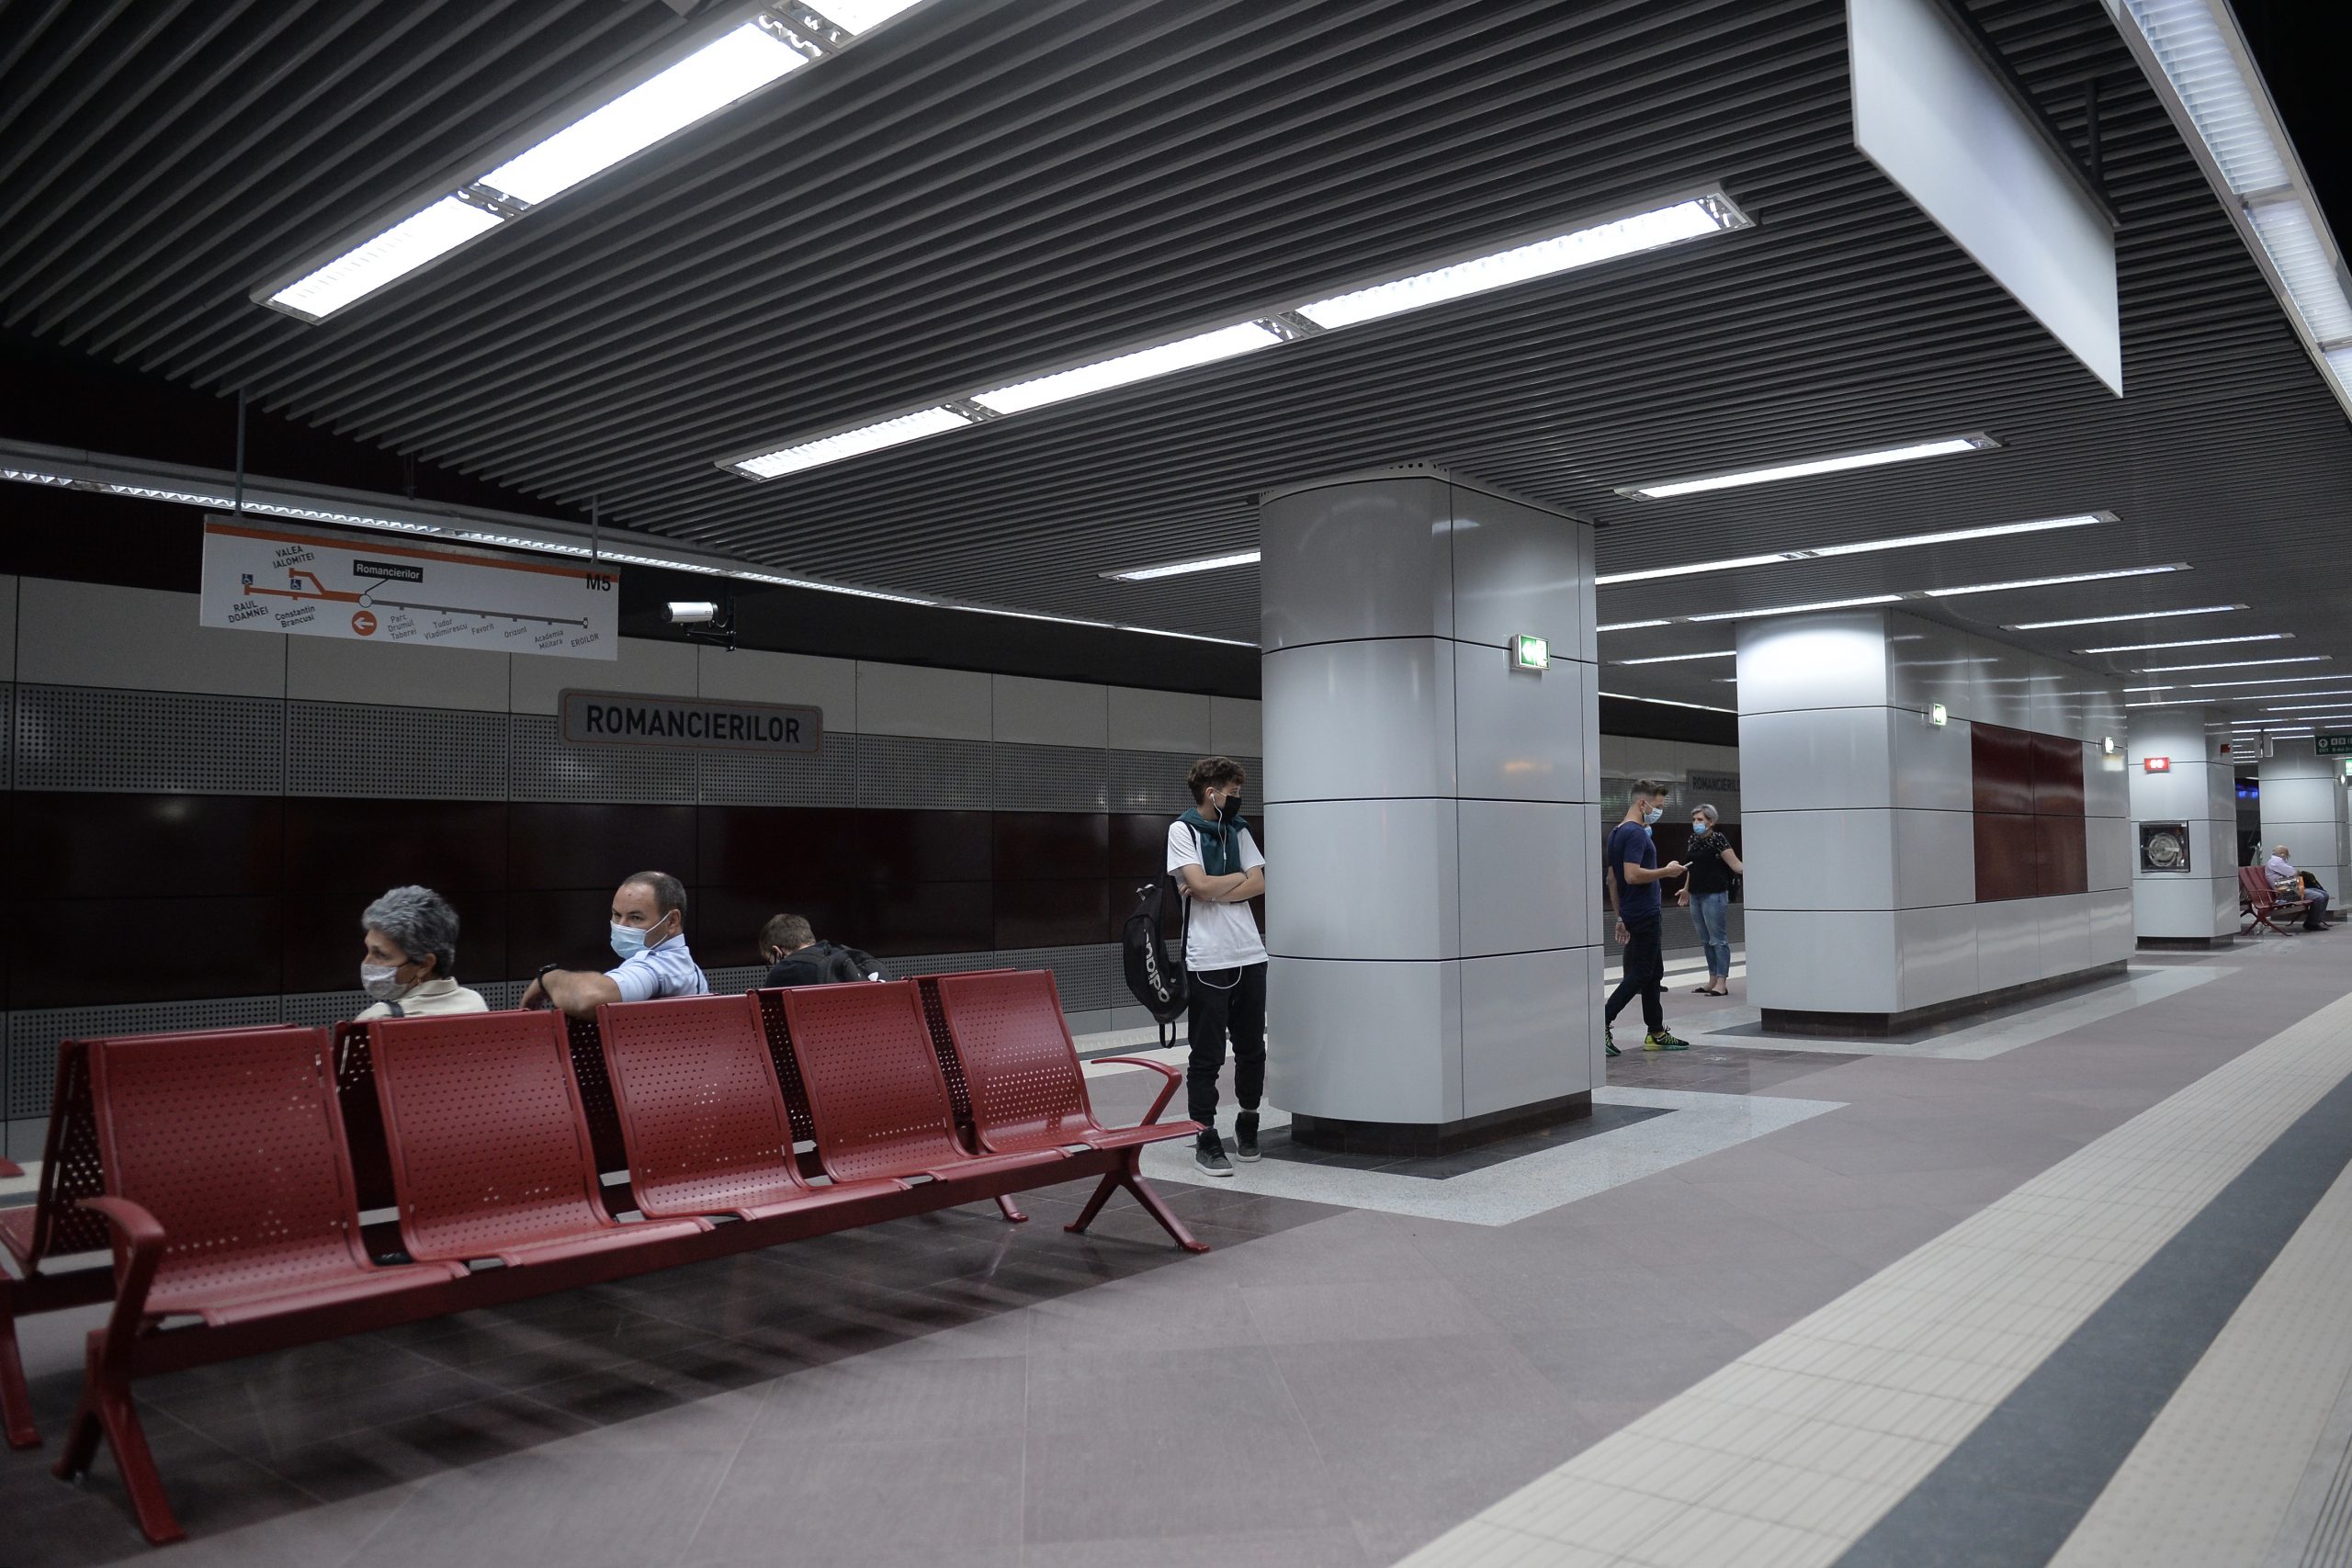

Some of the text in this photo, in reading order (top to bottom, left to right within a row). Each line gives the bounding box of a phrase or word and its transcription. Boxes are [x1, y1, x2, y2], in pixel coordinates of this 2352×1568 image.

[276, 546, 303, 557] VALEA
[273, 552, 314, 569] IALOMITEI
[356, 563, 420, 579] Romancierilor
[586, 573, 611, 592] M5
[233, 601, 257, 612] RAUL
[275, 605, 315, 621] Constantin
[228, 606, 268, 623] DOAMNEI
[281, 614, 314, 627] Brancusi
[390, 615, 407, 624] Parc
[387, 619, 414, 632] Drumul
[434, 619, 453, 629] Tudor
[471, 624, 494, 635] Favorit
[390, 628, 417, 640] Taberei
[424, 624, 468, 640] Vladimirescu
[503, 626, 527, 637] Orizont
[535, 629, 564, 643] Academia
[586, 705, 800, 743] ROMANCIERILOR
